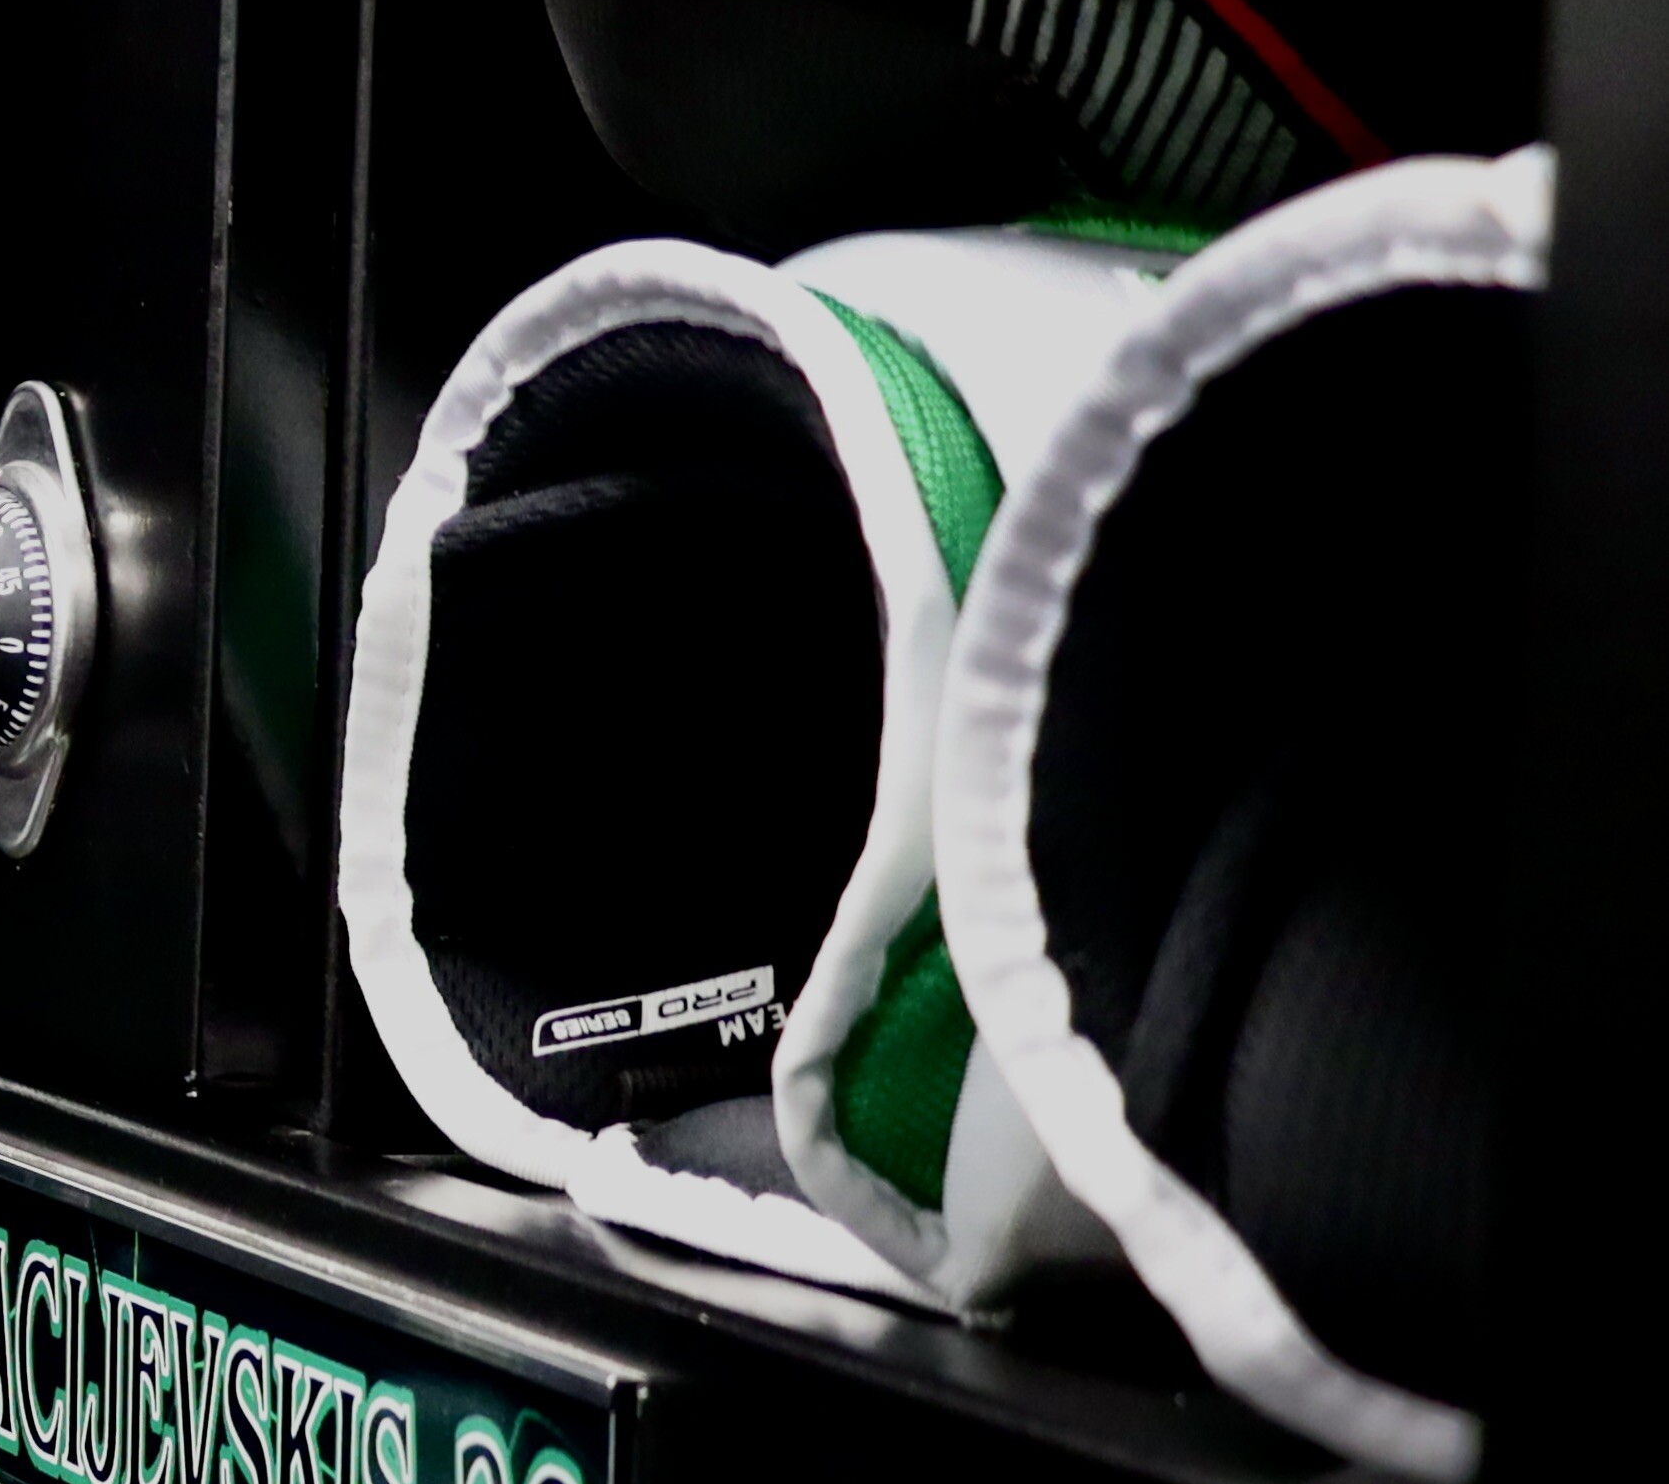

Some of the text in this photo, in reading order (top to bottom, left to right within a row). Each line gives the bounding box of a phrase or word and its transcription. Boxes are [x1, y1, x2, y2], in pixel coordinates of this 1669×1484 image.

[550, 977, 757, 1042] PRO SERIES
[716, 1001, 788, 1048] EAM
